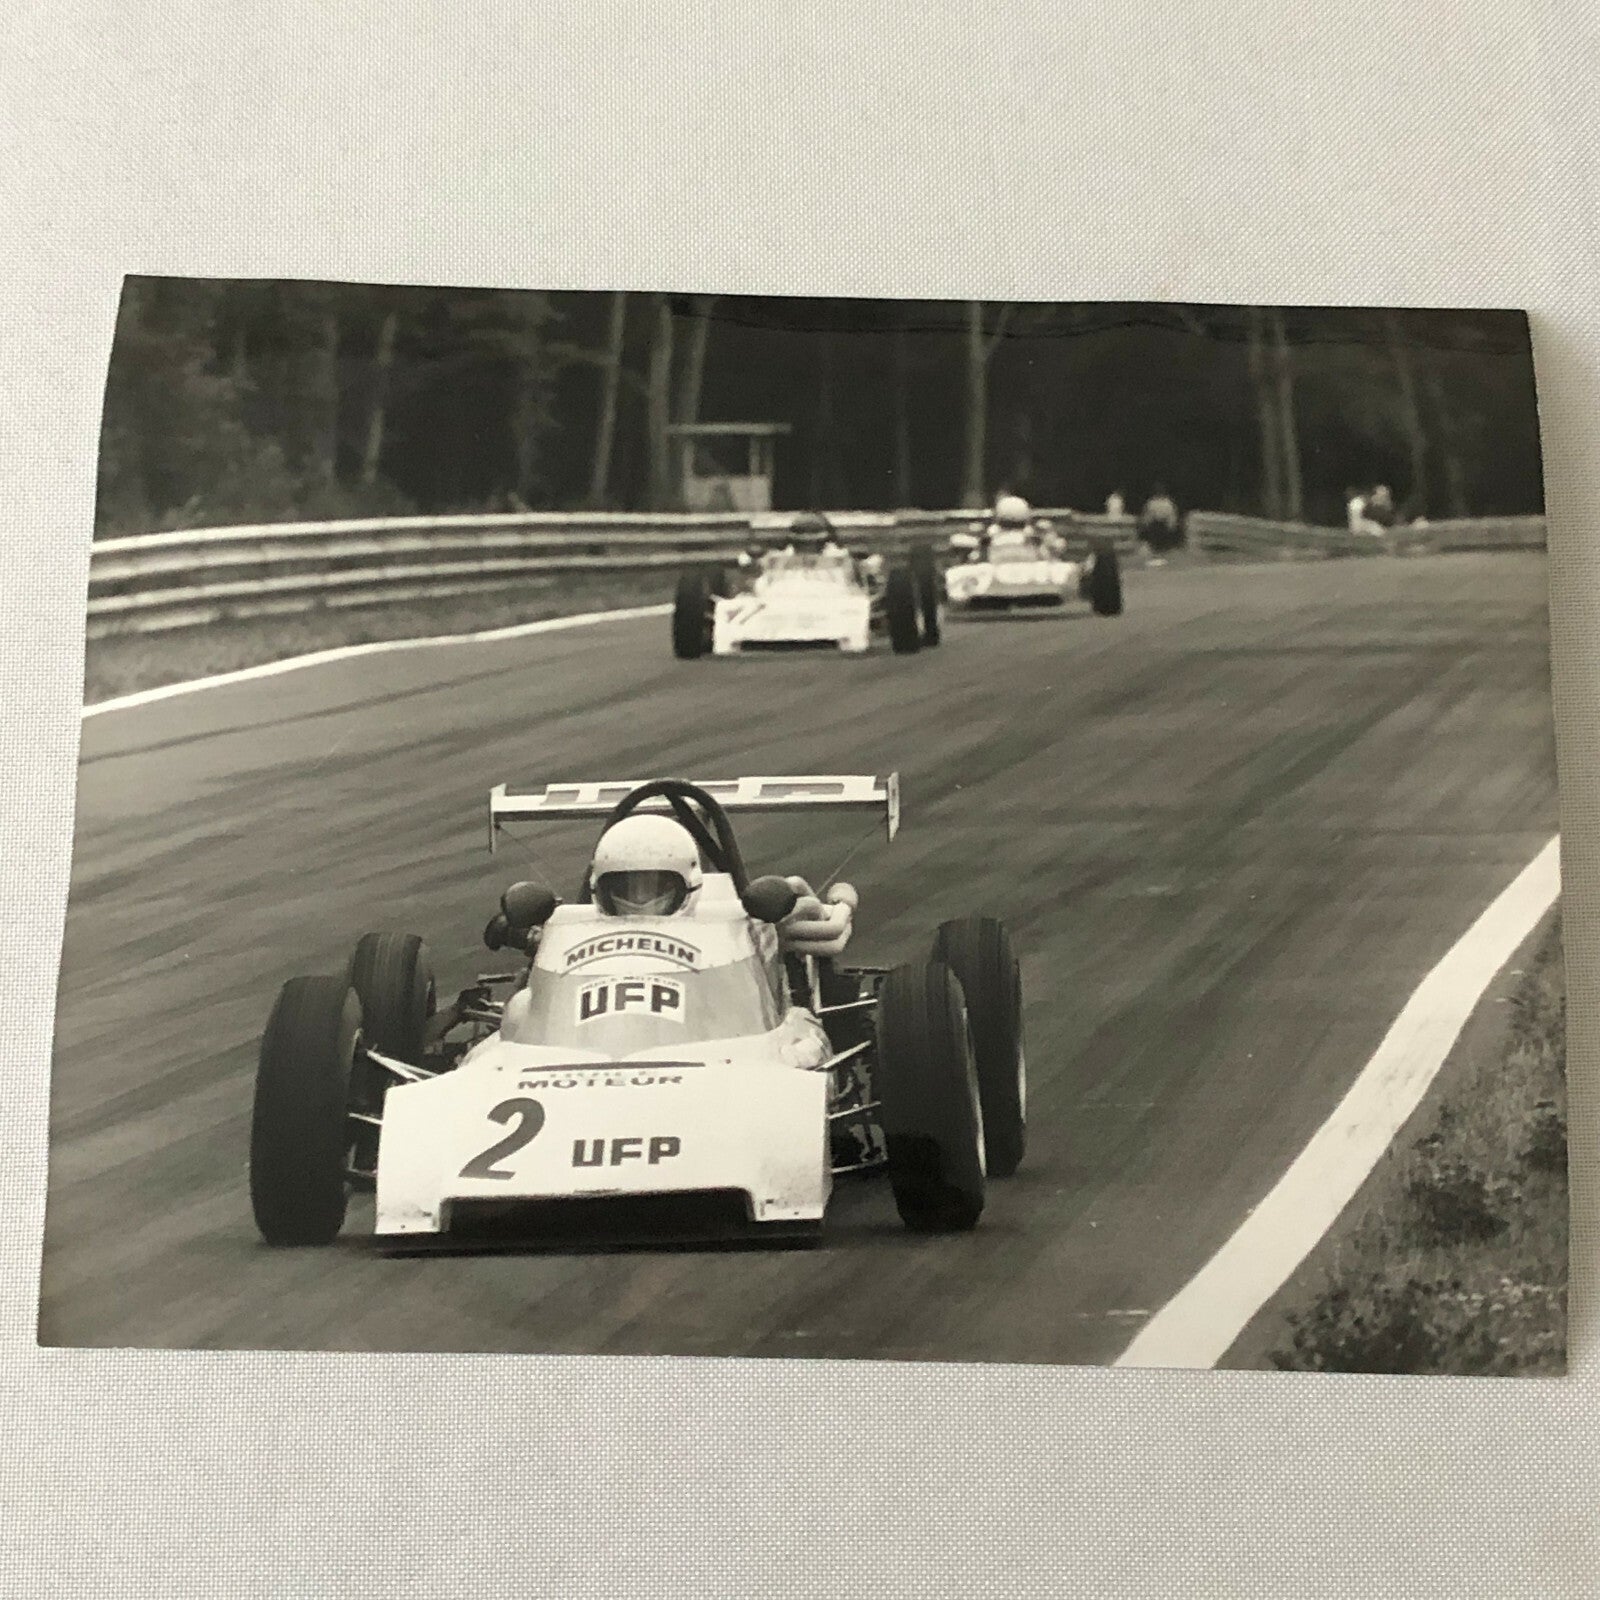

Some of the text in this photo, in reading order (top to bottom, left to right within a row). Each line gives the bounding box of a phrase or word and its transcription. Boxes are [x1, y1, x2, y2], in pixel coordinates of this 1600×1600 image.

[566, 937, 695, 966] MICHELIN
[580, 982, 680, 1020] UFP
[517, 1075, 683, 1089] MOTEUR
[459, 1097, 546, 1180] 2
[572, 1136, 681, 1167] UFP
